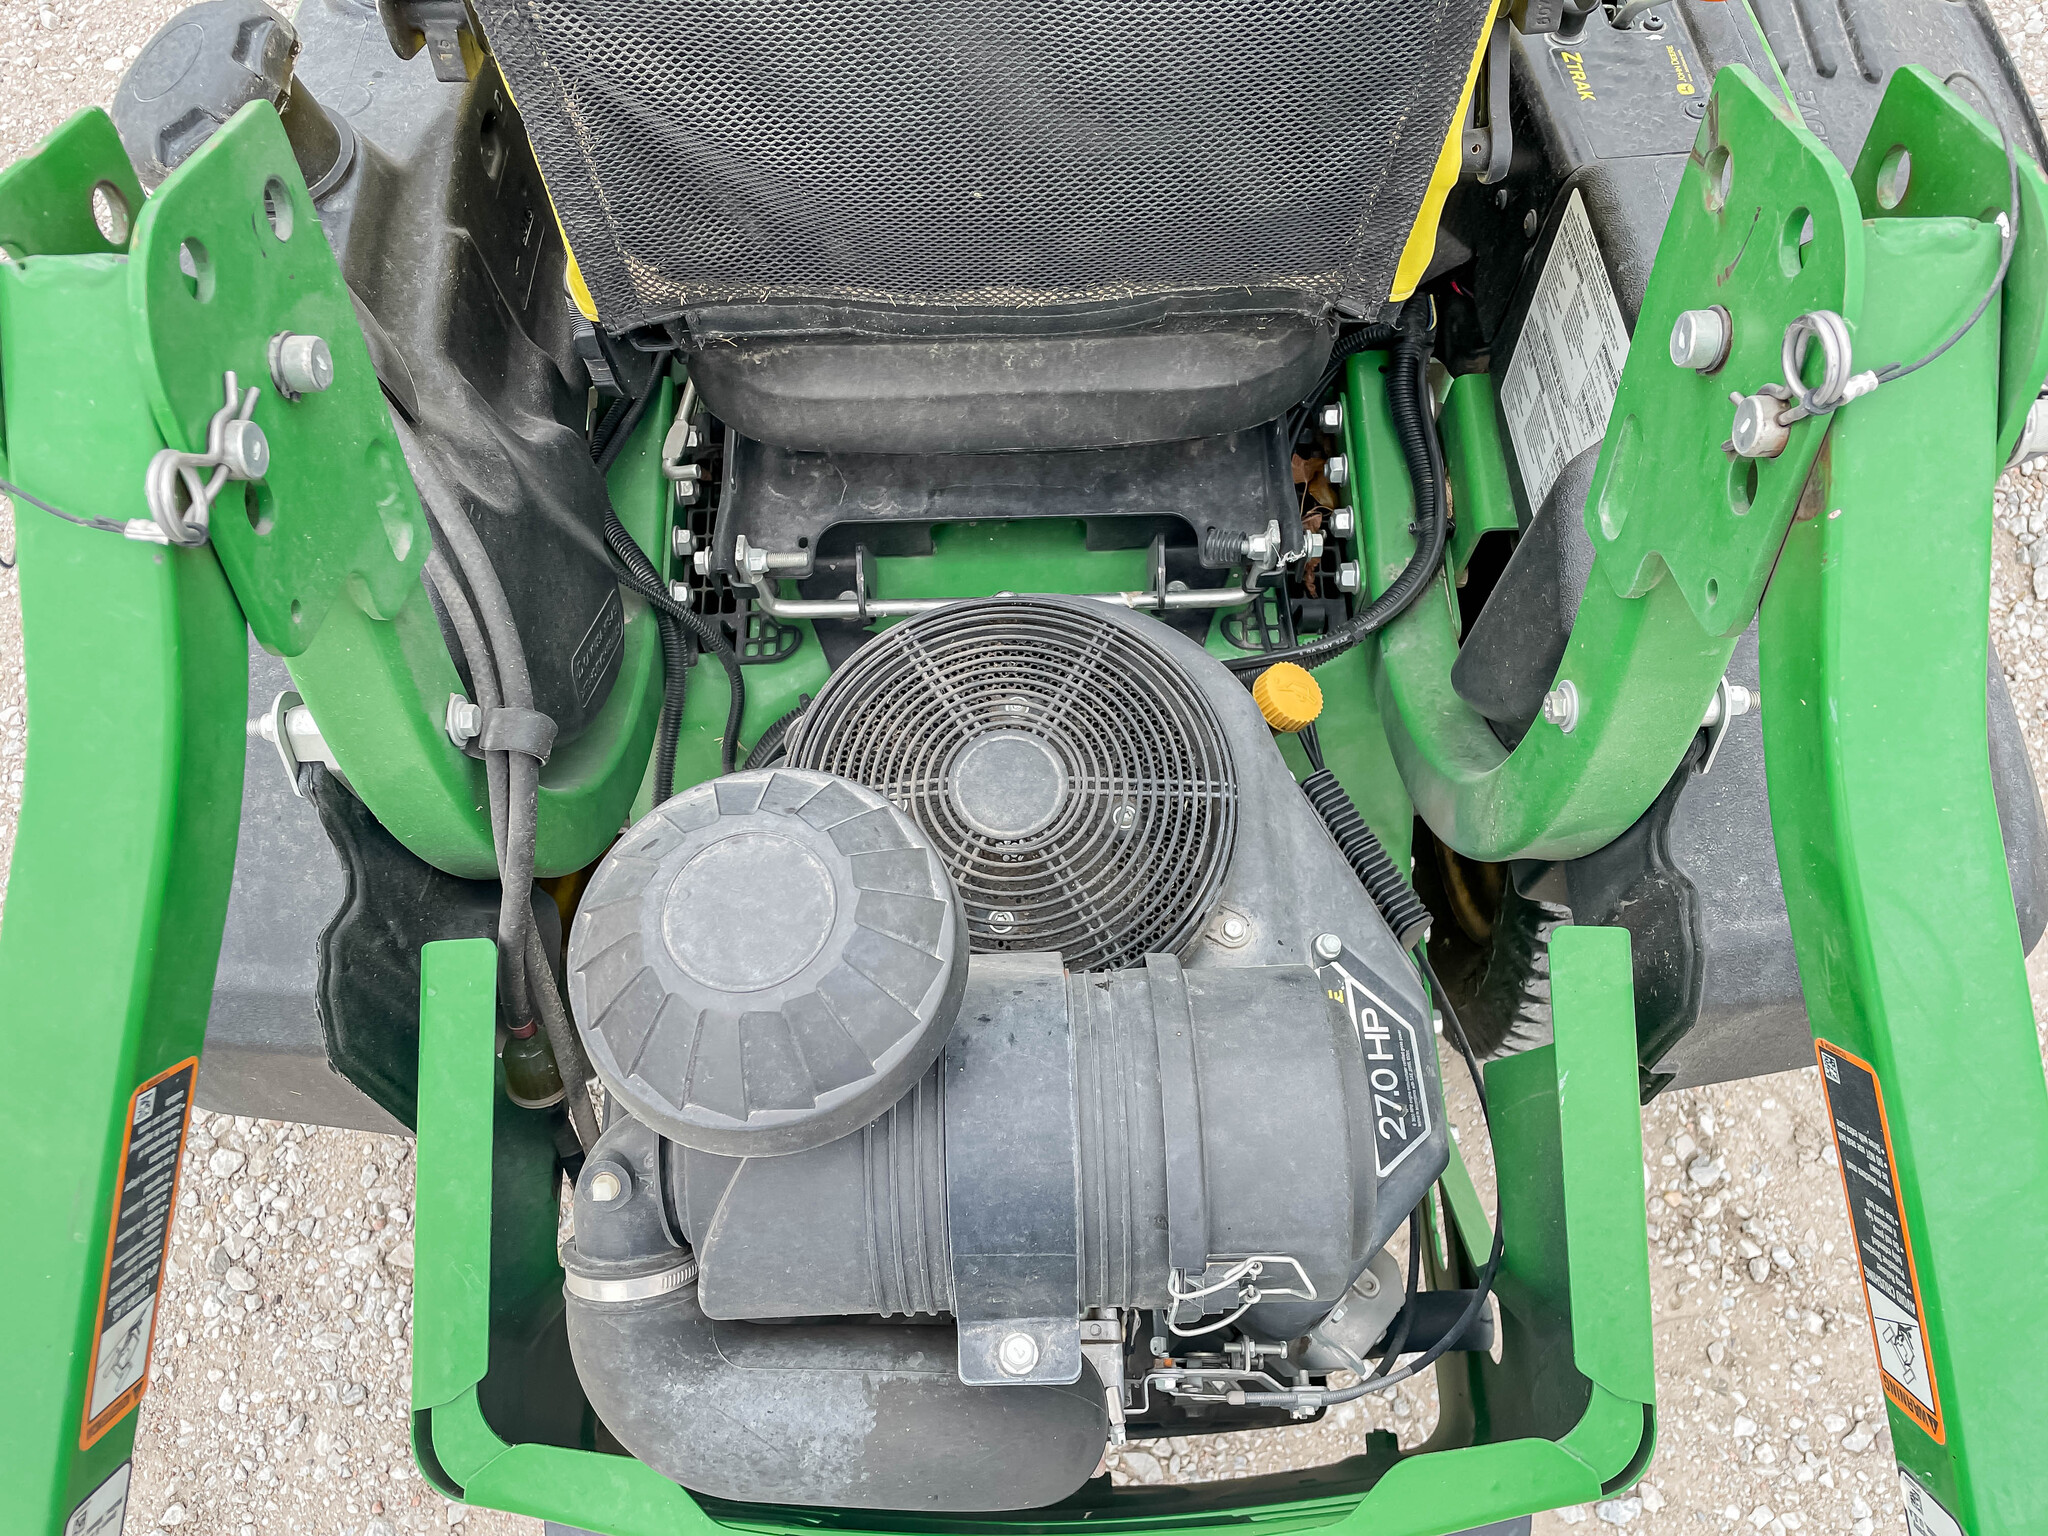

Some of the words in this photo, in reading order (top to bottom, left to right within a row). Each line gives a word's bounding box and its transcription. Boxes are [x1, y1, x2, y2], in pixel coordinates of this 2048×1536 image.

[1560, 51, 1597, 101] ZTRAK
[1665, 44, 1679, 66] DEERE
[1673, 64, 1686, 83] JOHN
[1361, 1007, 1394, 1060] HP
[1370, 1068, 1408, 1140] 27.0
[1863, 1264, 1895, 1299] CRUSHING
[1895, 1288, 1916, 1316] AVOID
[1882, 1373, 1928, 1428] WARNING
